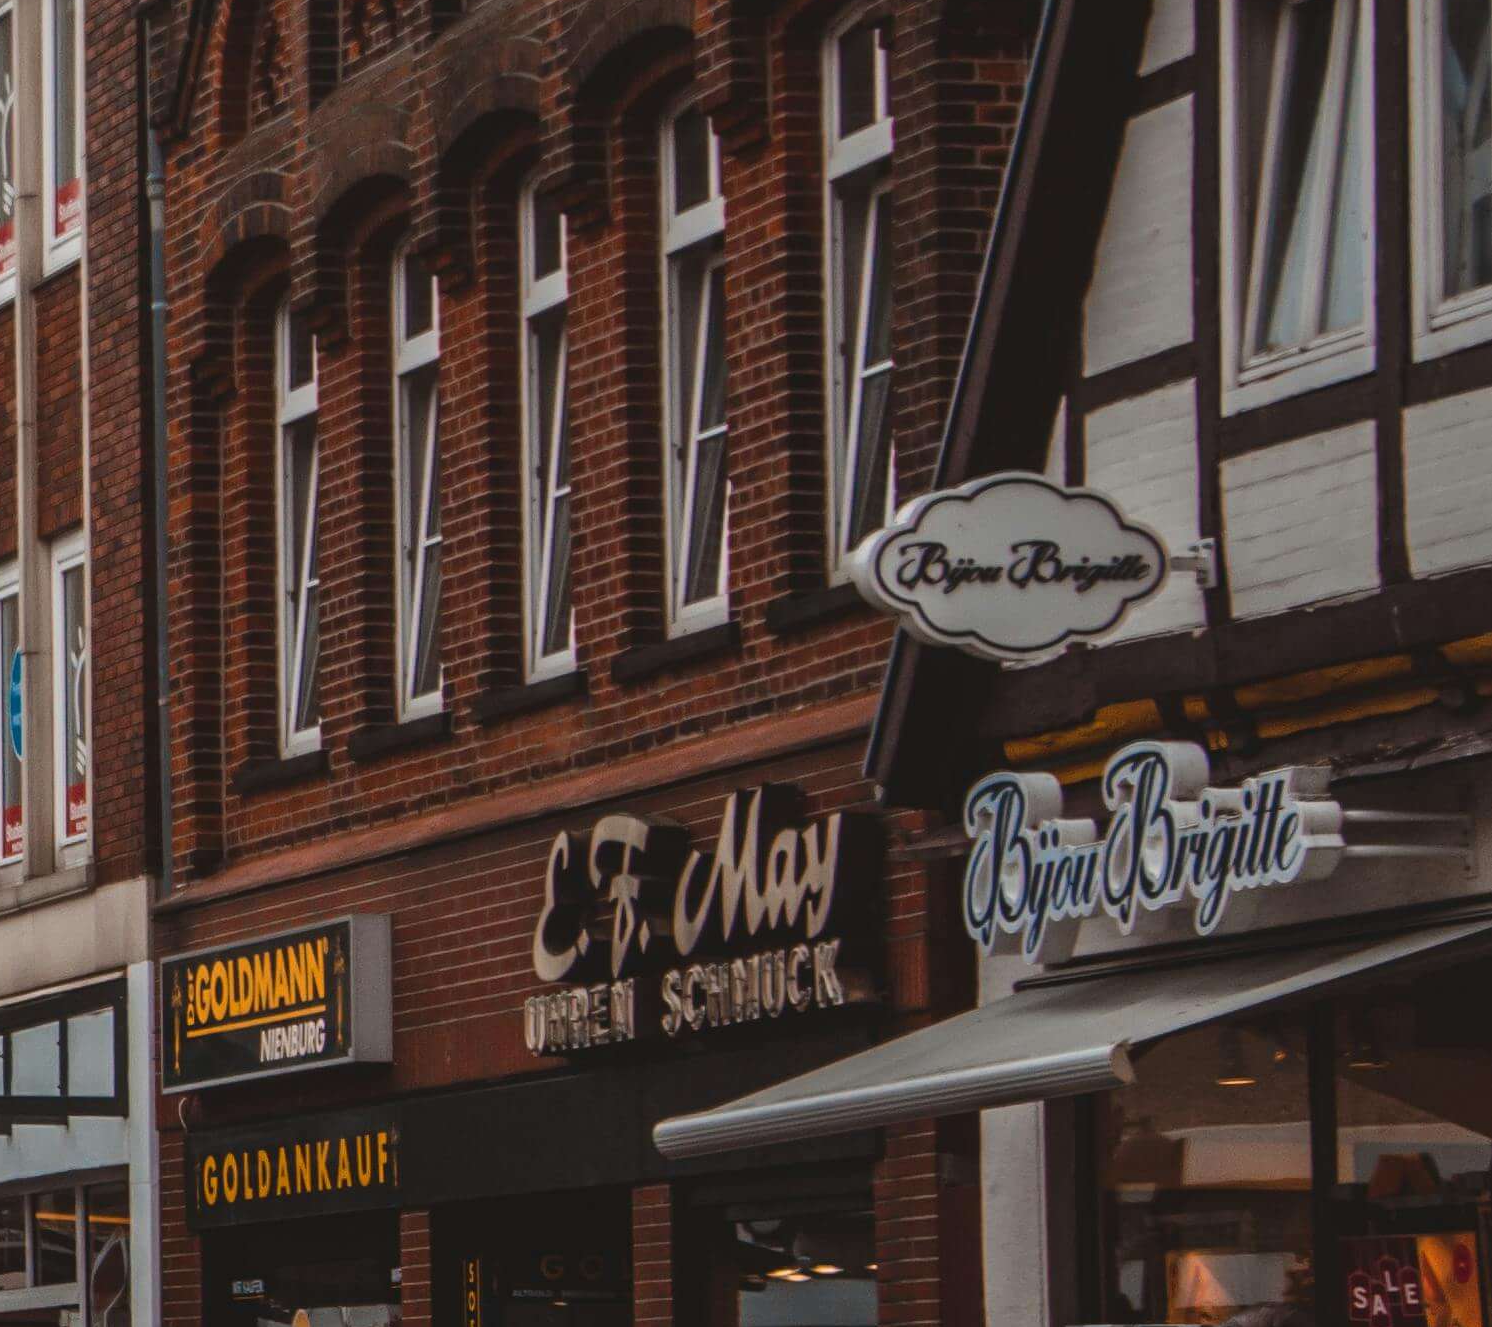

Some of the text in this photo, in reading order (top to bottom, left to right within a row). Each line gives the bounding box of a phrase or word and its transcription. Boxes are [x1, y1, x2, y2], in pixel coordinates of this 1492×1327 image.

[897, 540, 1151, 595] Bijou Brigitte
[674, 786, 842, 957] May
[967, 751, 1301, 954] Bijou Brigitte
[195, 936, 327, 1025] GOLDMANN
[524, 937, 845, 1057] UHREN SCHMUCK
[260, 1018, 327, 1063] NIENBURG
[202, 1128, 389, 1207] GOLDANKAUF
[1352, 1271, 1420, 1316] SALE
